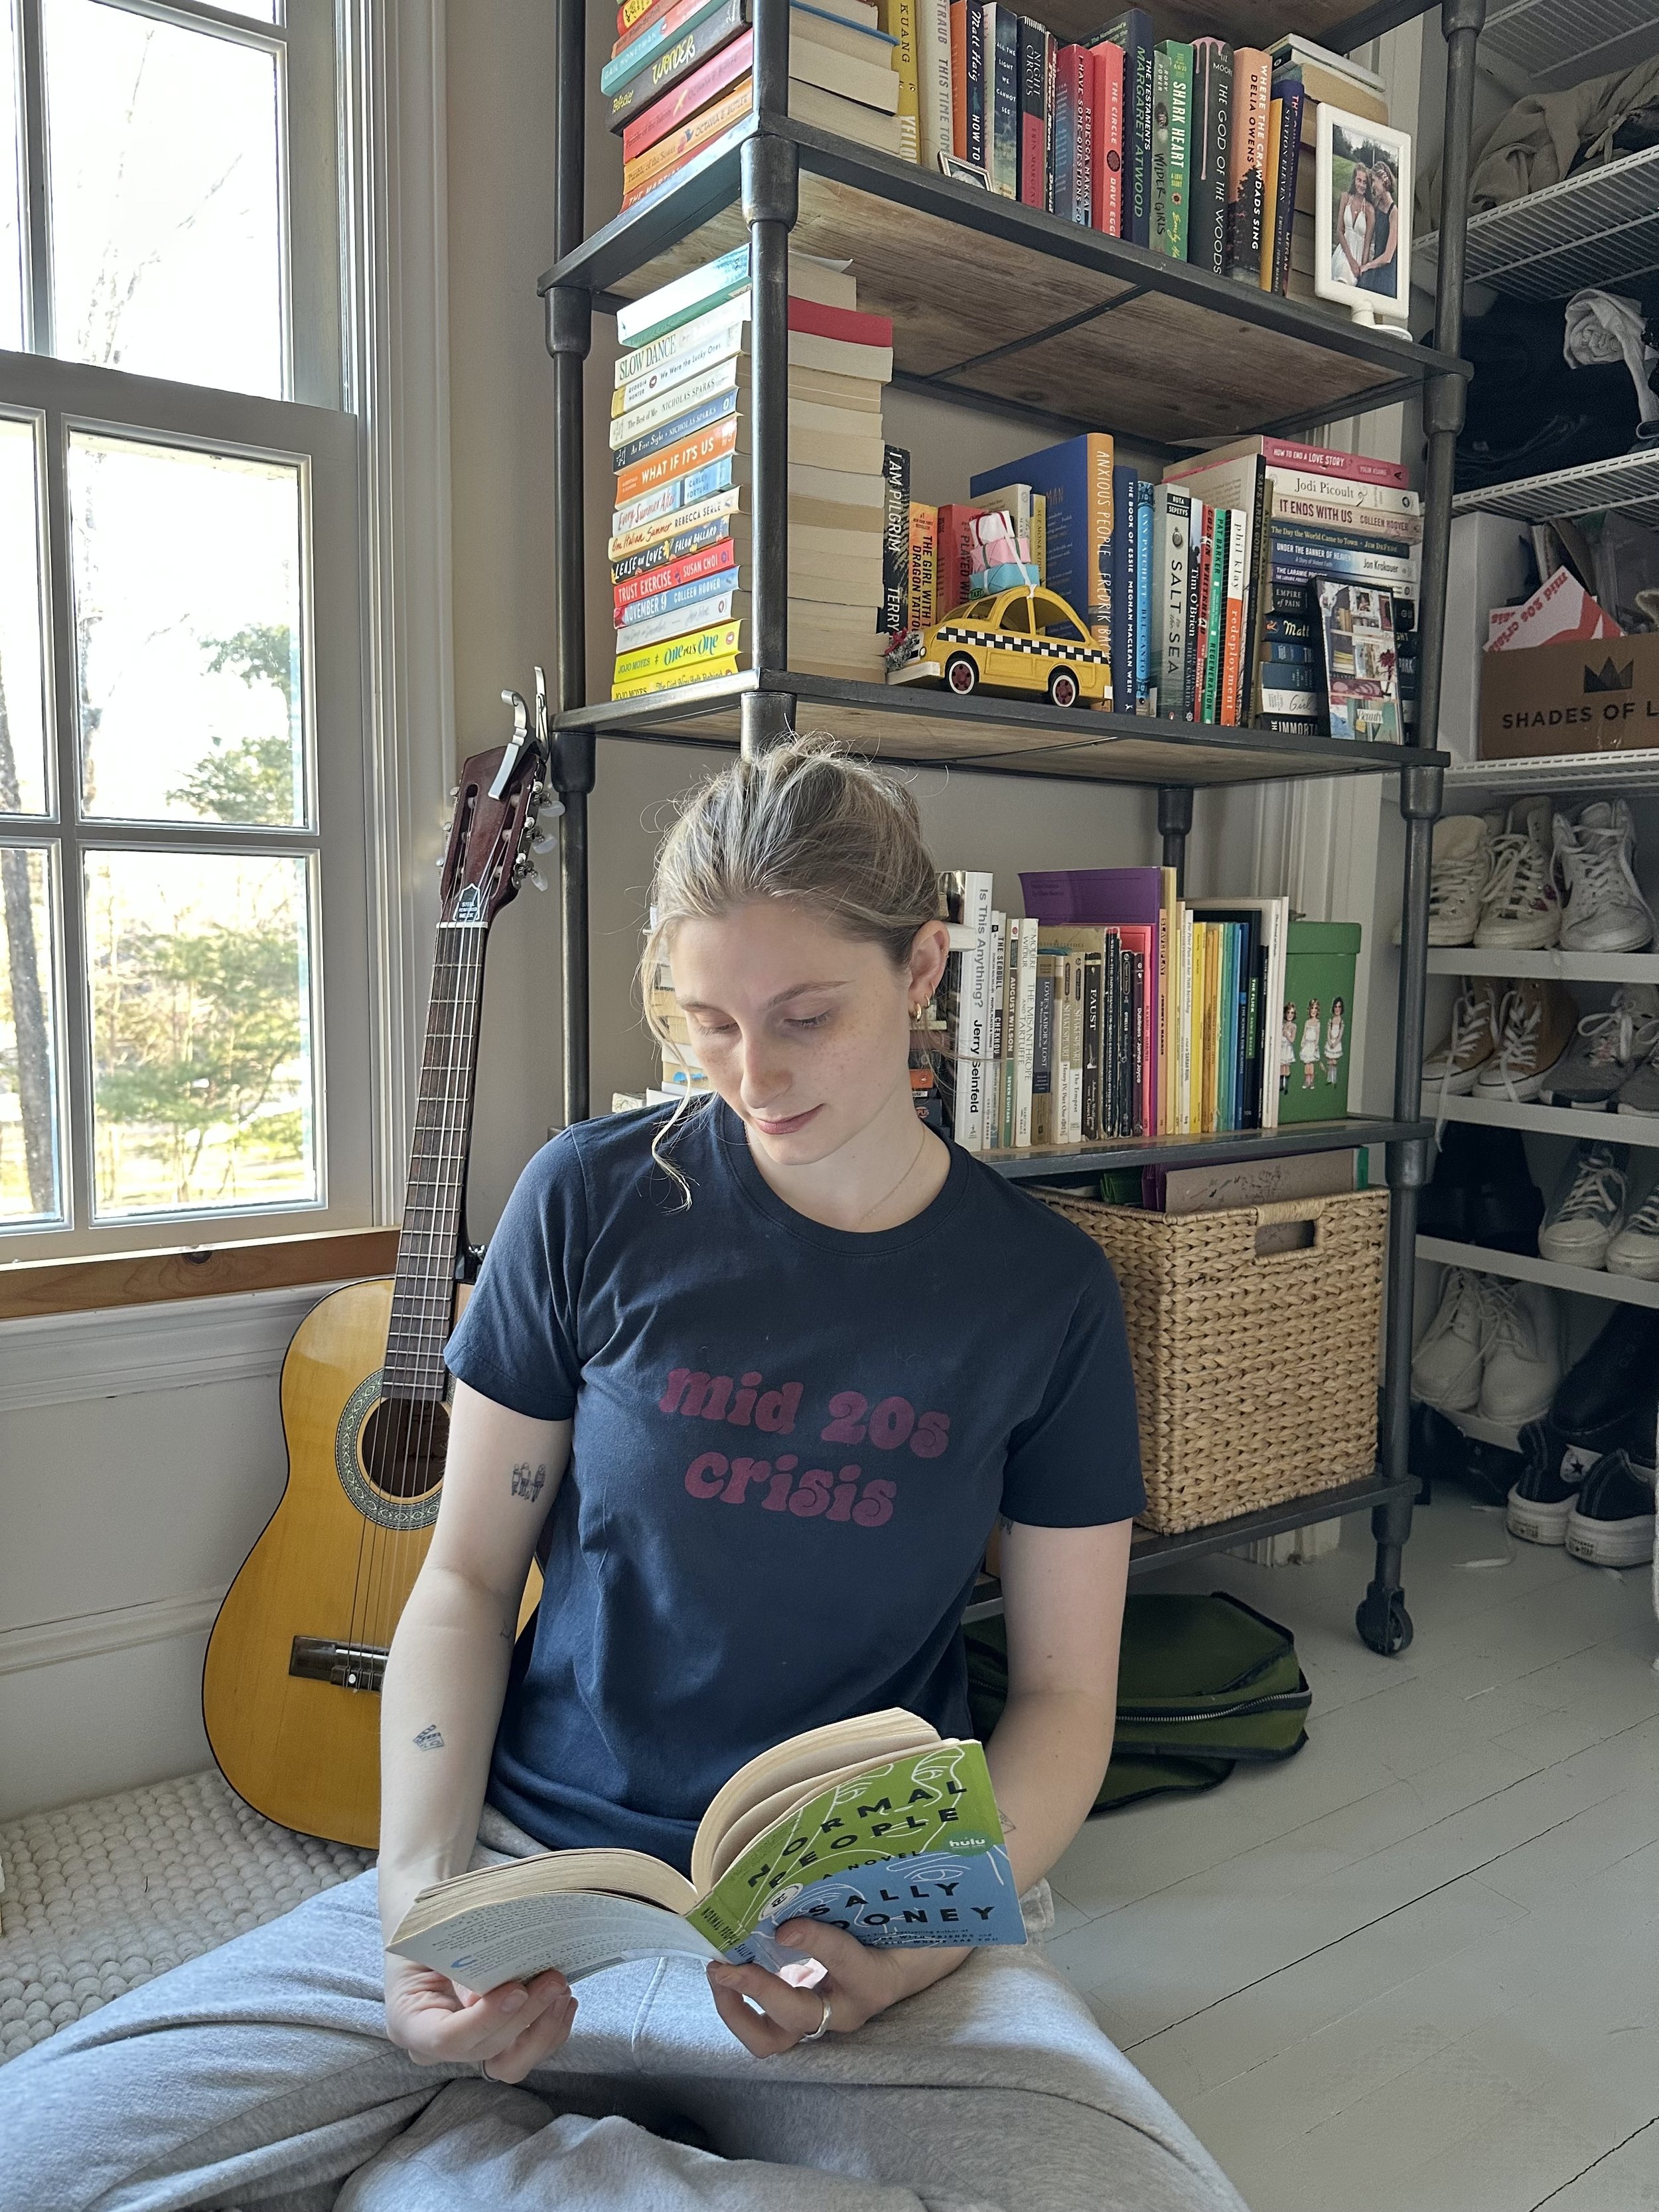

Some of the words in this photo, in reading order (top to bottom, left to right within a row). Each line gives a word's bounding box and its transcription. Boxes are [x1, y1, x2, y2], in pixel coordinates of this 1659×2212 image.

[900, 4, 910, 64] KUANG
[972, 11, 981, 45] Matt
[652, 35, 695, 84] WONDER
[938, 59, 949, 90] THIS
[968, 51, 981, 82] Haig
[999, 59, 1013, 70] LIGHT
[996, 88, 1016, 102] CANNOT
[1135, 46, 1145, 141] MARGARET
[1172, 82, 1187, 124] SHARK
[1218, 84, 1228, 106] THE
[1250, 74, 1258, 111] DELIA
[1258, 65, 1268, 110] WHERE
[939, 92, 950, 124] TIME
[972, 114, 981, 145] HOW
[1217, 110, 1227, 150] GOD
[1247, 117, 1256, 163] OWENS
[1257, 114, 1265, 139] THE
[972, 147, 981, 161] TO
[1171, 128, 1185, 168] HEART
[1134, 145, 1144, 218] ATWOOD
[1154, 153, 1167, 198] WILDER
[1216, 156, 1226, 176] OF
[1254, 143, 1265, 215] CRAWDADS
[1216, 181, 1225, 202] THE
[1155, 202, 1166, 235] GIRLS
[1213, 209, 1224, 275] WOODS
[619, 352, 644, 380] SLOW
[646, 334, 676, 366] DANCE
[692, 349, 706, 364] Lucky
[707, 342, 721, 354] Ones
[662, 388, 691, 411] NICHOLAS
[691, 378, 715, 396] SPARKS
[669, 417, 695, 435] NICHOLAS
[696, 406, 717, 423] SPARKS
[641, 460, 667, 484] WHAT
[670, 455, 681, 471] IF
[682, 445, 698, 465] IT'S
[701, 437, 714, 455] US
[889, 461, 902, 486] AM
[1309, 453, 1324, 464] LOVE
[1325, 456, 1344, 467] STORY
[1097, 451, 1110, 506] ANXIOUS
[1295, 478, 1316, 492] Jodi
[1320, 482, 1354, 498] Picoult
[674, 510, 701, 528] REBECCA
[703, 502, 721, 518] SERLE
[1169, 506, 1189, 517] SEPETYS
[1173, 495, 1185, 504] RUTA
[1279, 498, 1289, 512] IT
[1290, 501, 1314, 517] ENDS
[1316, 504, 1338, 521] WITH
[1340, 510, 1352, 524] US
[1360, 515, 1385, 528] COLLEEN
[1386, 519, 1409, 531] HOOVER
[889, 489, 902, 552] PILGRIM
[1097, 512, 1111, 556] PEOPLE
[615, 557, 636, 579] LEASE
[646, 546, 663, 567] LOVE
[675, 536, 693, 552] FALON
[693, 526, 717, 545] BALLARD
[923, 536, 932, 557] THE
[1128, 532, 1133, 544] OF
[1234, 523, 1244, 553] phil
[1277, 543, 1294, 553] UNDER
[1295, 545, 1304, 554] THE
[1305, 547, 1325, 557] BANNER
[1304, 531, 1321, 541] World
[1321, 534, 1336, 543] Came
[1344, 538, 1358, 547] Town
[912, 546, 921, 592] DRAGON
[922, 559, 932, 585] GIRL
[1214, 538, 1223, 574] BARKER
[1287, 568, 1308, 577] LARAMIE
[618, 582, 638, 603] TRUST
[640, 570, 672, 595] EXERCISE
[683, 562, 701, 577] SUSAN
[703, 554, 718, 571] CHOI
[1170, 559, 1183, 614] SALT
[1190, 567, 1199, 590] Tim
[1232, 561, 1242, 589] klay
[624, 597, 659, 622] NOVEMBER
[661, 592, 668, 611] 9
[674, 588, 697, 603] COLLEEN
[698, 578, 721, 594] HOOVER
[887, 588, 900, 631] TERRY
[922, 590, 932, 619] WITH
[1097, 572, 1111, 623] FREDRIK
[1276, 589, 1301, 599] EMPIRE
[1285, 599, 1301, 608] PAIN
[1189, 593, 1199, 637] O'Brien
[618, 662, 632, 674] JOJO
[632, 658, 650, 669] MOYES
[1168, 632, 1180, 674] SEA
[1226, 610, 1239, 709] redeployment
[1206, 643, 1216, 709] REGENERATION
[1502, 707, 1592, 729] SHADES
[1603, 702, 1635, 721] OF
[979, 889, 988, 901] Is
[978, 905, 987, 934] This
[973, 938, 985, 1008] Anything?
[971, 1019, 982, 1055] Jerry
[1024, 1006, 1034, 1081] MISANTHROPE
[970, 1060, 980, 1113] Seinfeld
[658, 1368, 804, 1435] mid
[821, 1391, 951, 1458] 20s
[684, 1451, 897, 1526] crisis
[748, 1781, 967, 1887] NORMAL
[768, 1807, 959, 1889] PEOPLE
[949, 1837, 985, 1848] hulu
[847, 1850, 920, 1870] NOVEL
[809, 1882, 960, 1917] SALLY
